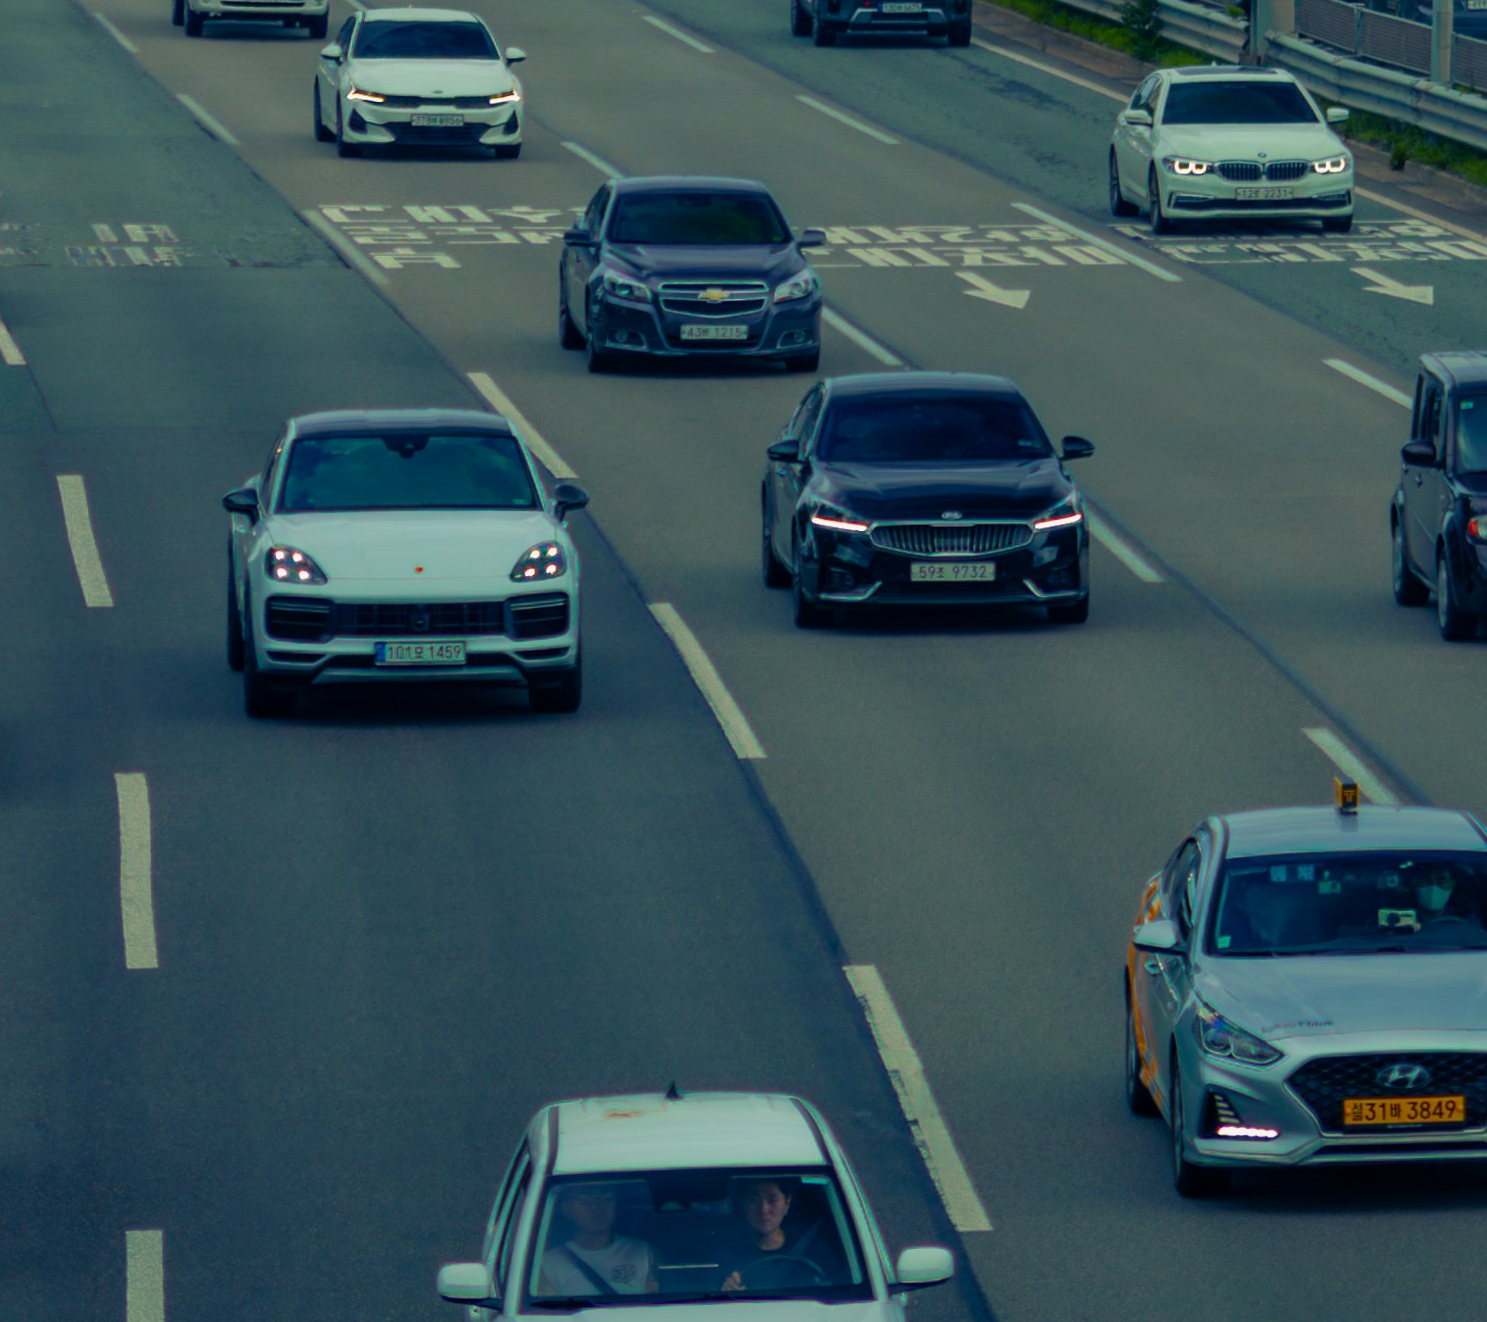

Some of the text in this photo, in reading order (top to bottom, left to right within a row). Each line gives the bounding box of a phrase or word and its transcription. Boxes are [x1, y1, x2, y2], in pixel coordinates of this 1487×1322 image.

[714, 326, 742, 337] 1215
[952, 565, 987, 578] 9732
[389, 644, 463, 659] 101모 1459
[1365, 1101, 1402, 1121] 31바
[1406, 1099, 1457, 1119] 3849
